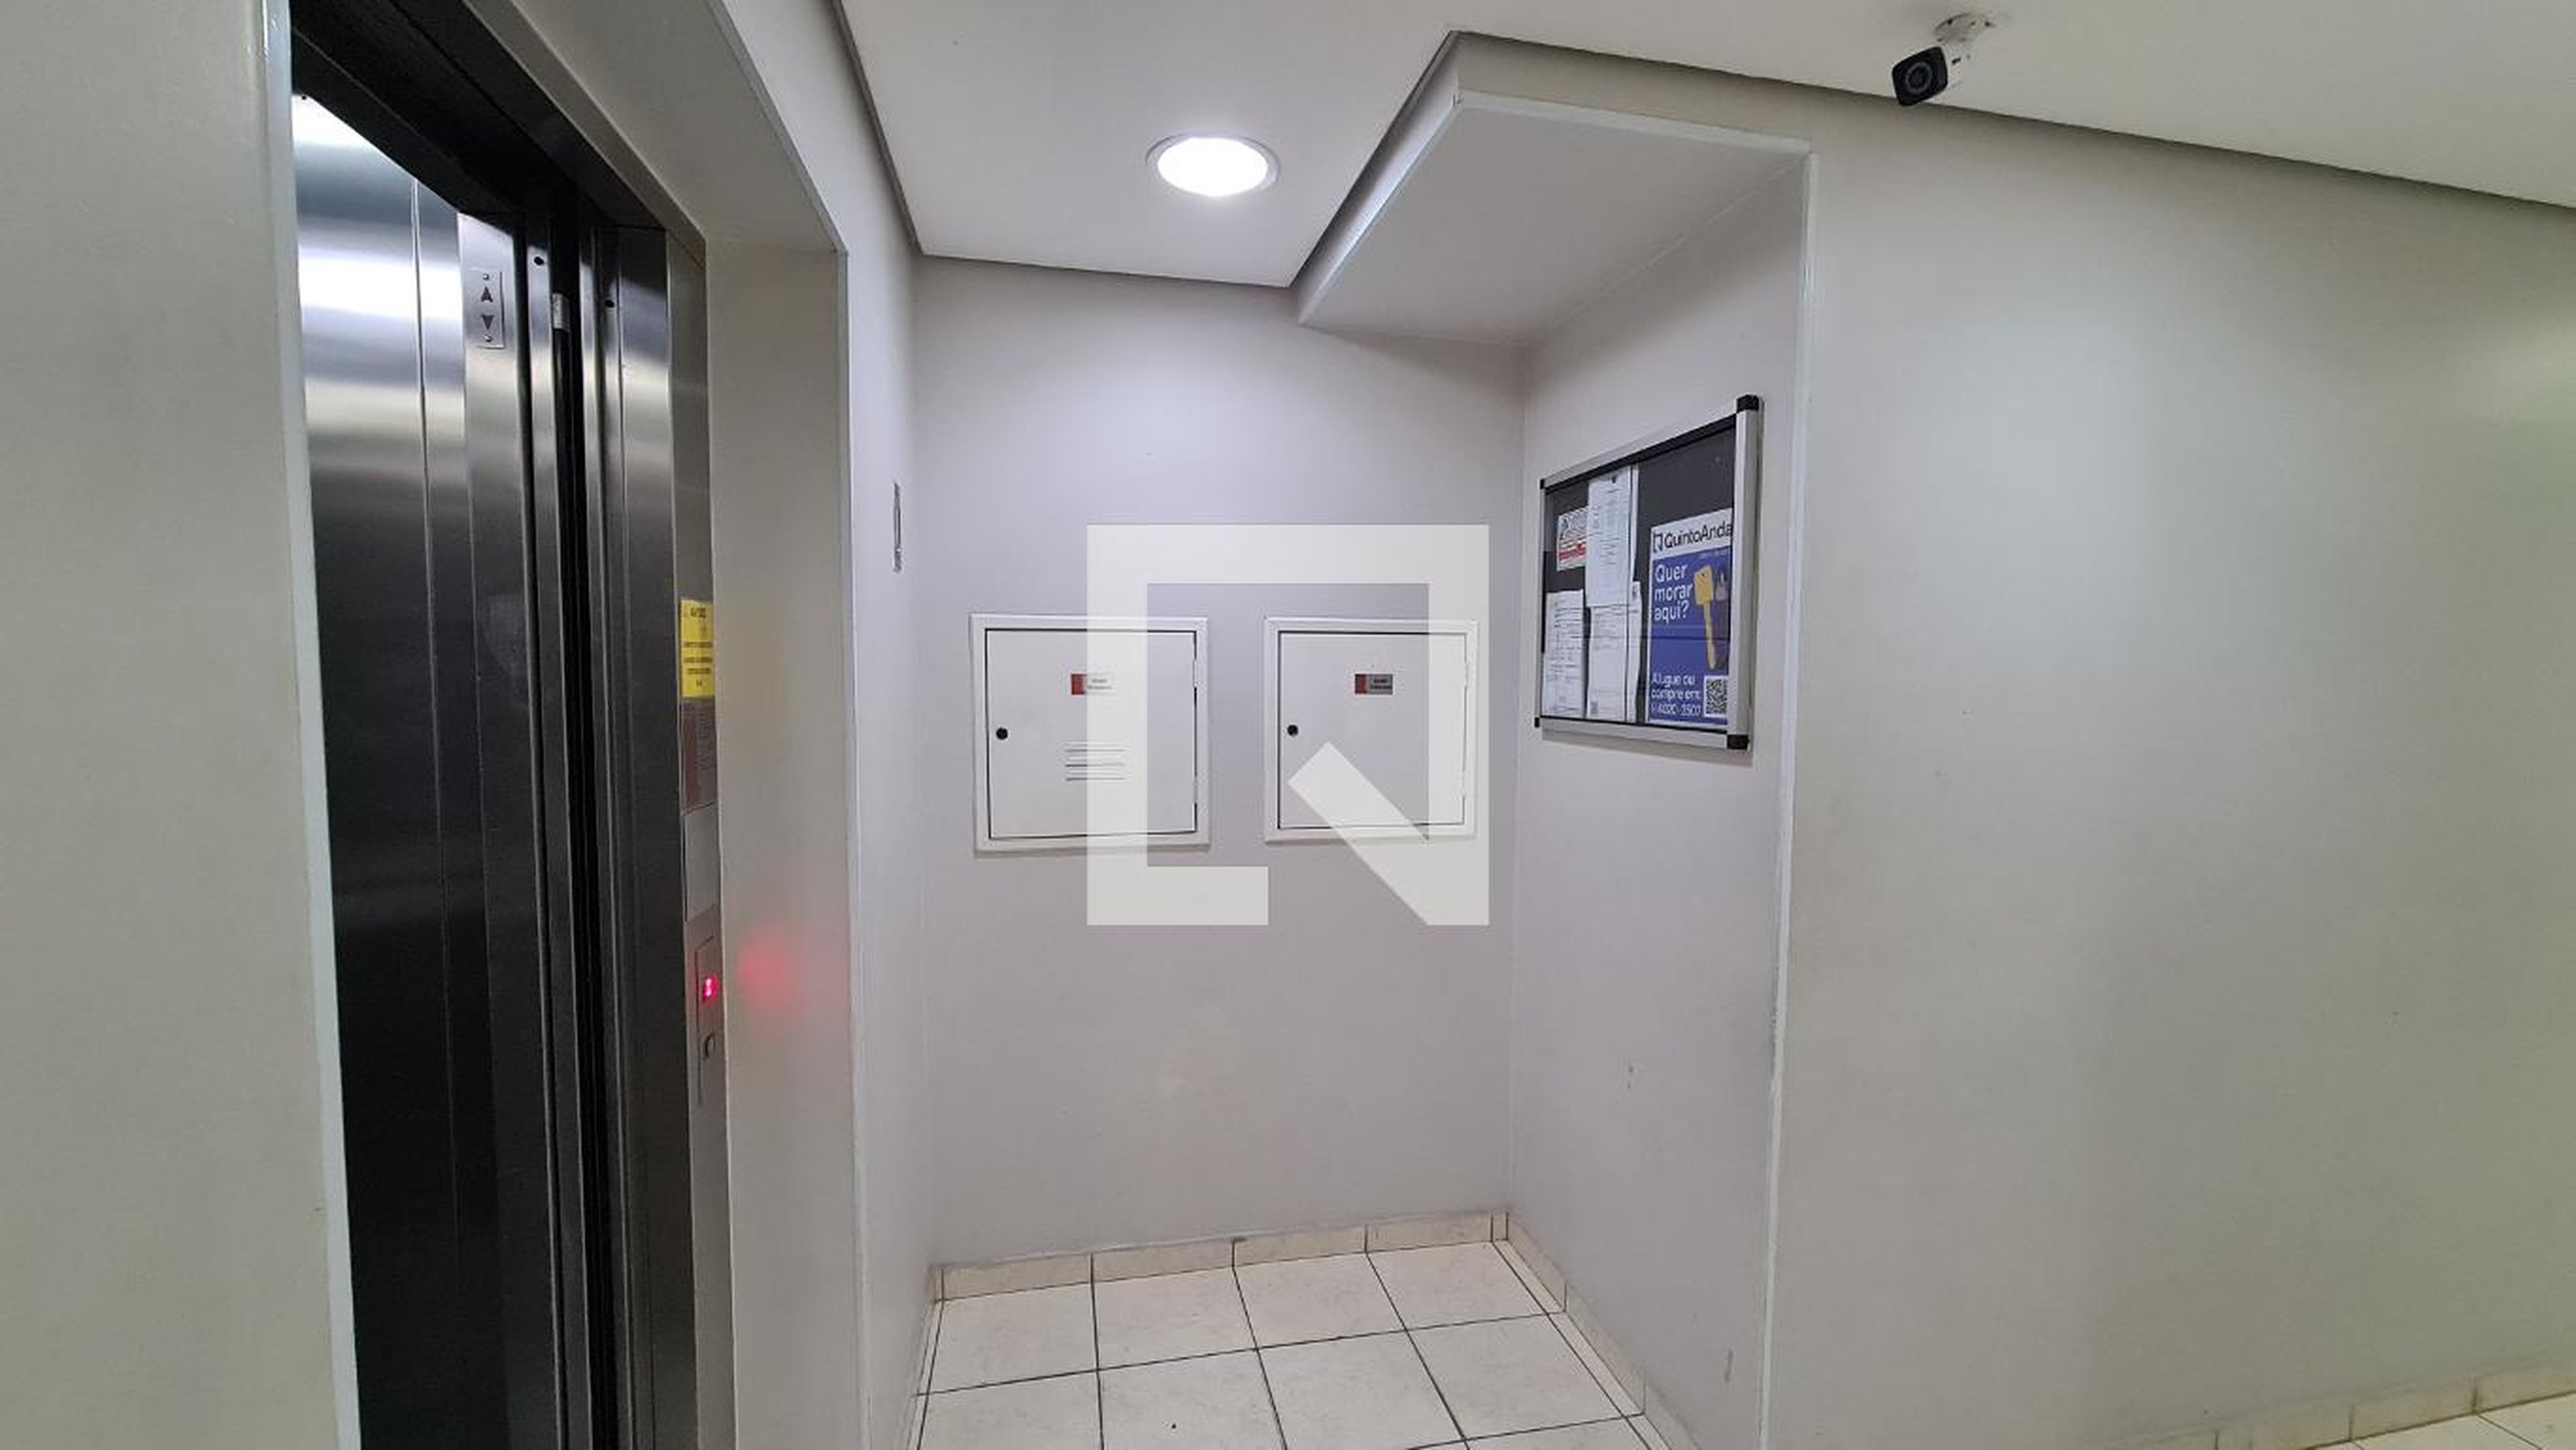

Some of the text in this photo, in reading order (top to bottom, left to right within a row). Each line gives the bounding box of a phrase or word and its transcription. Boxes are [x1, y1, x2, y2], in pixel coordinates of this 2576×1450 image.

[1664, 520, 1732, 549] QuintoAnda
[1655, 564, 1688, 583] Quer
[1654, 584, 1693, 601] morar
[1654, 601, 1689, 625] aqui?
